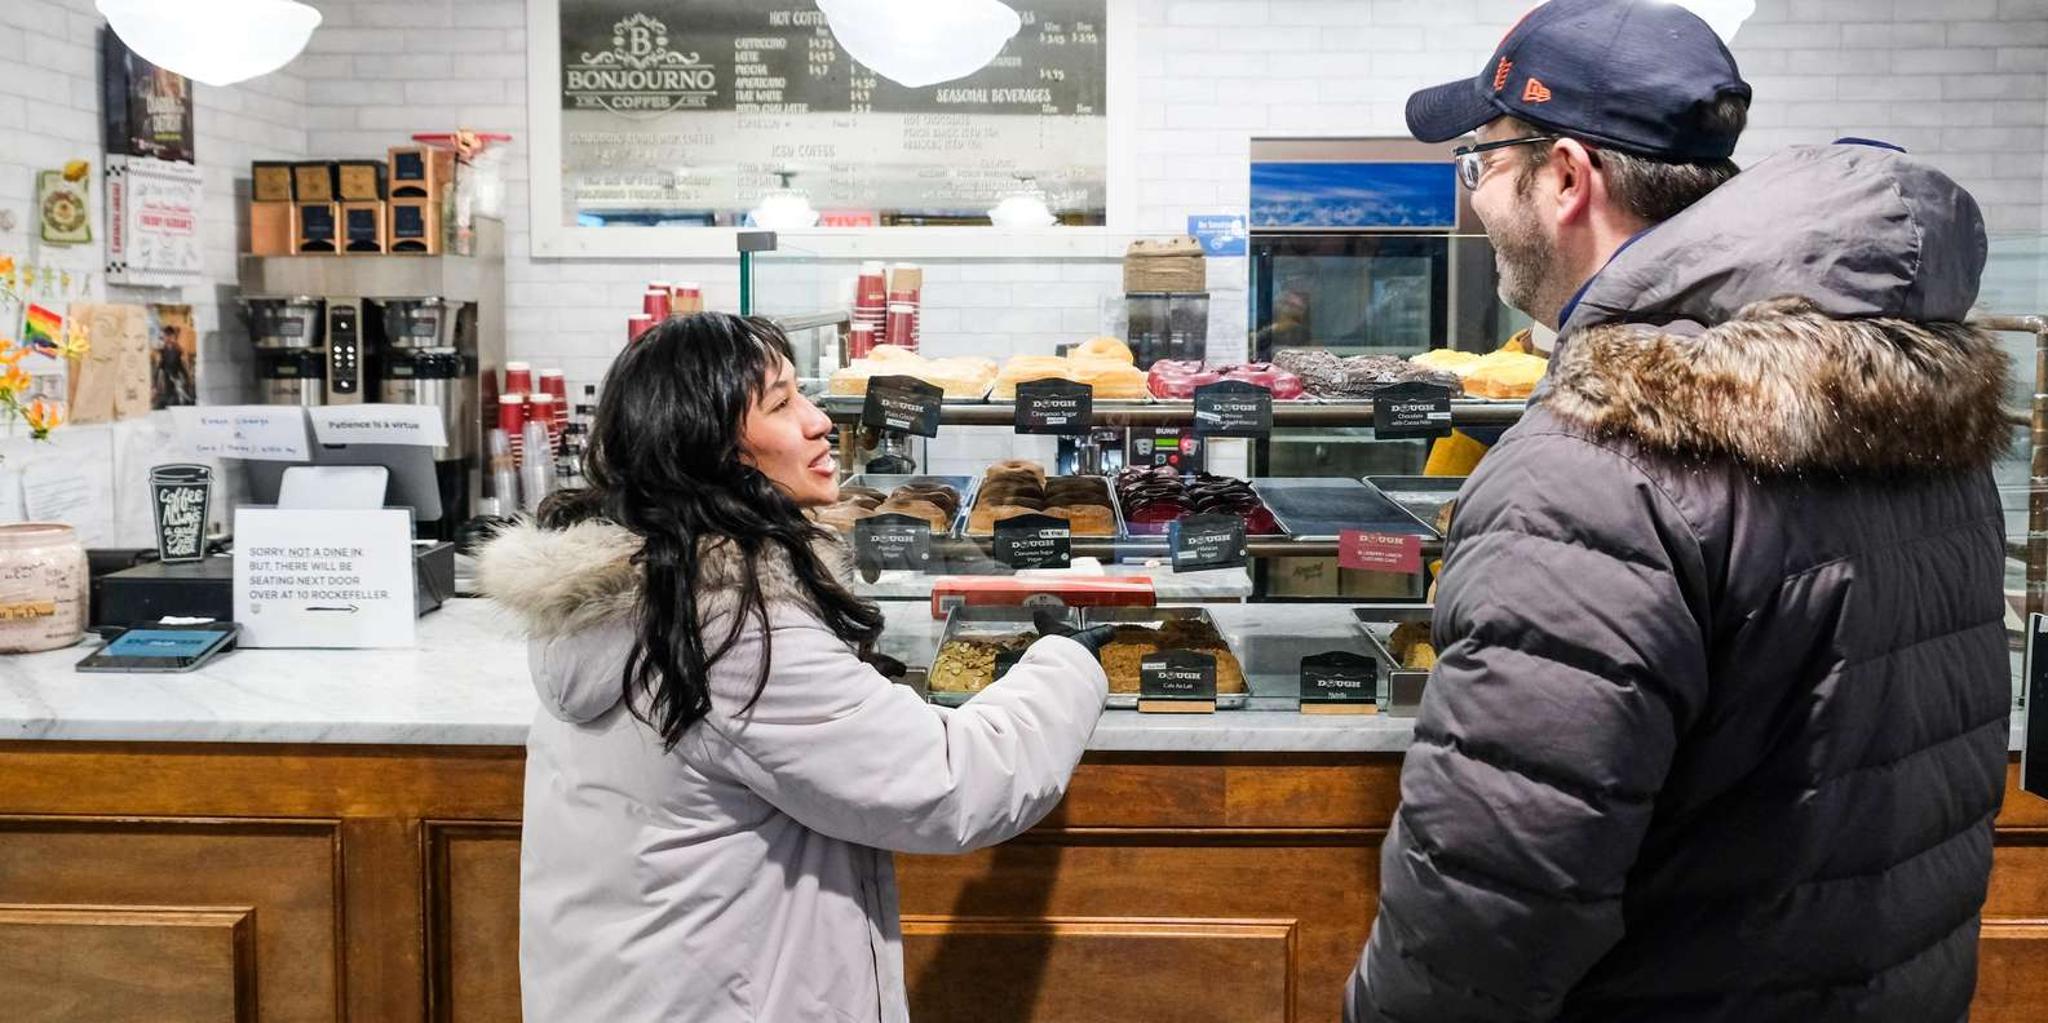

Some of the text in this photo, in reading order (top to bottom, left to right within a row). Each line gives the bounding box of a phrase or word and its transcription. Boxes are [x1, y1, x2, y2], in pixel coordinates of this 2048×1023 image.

[769, 11, 791, 26] HOT
[630, 27, 651, 56] B
[566, 70, 716, 90] BONJOURNO
[936, 88, 1052, 103] SEASONAL BEVERAGES
[612, 96, 670, 109] COFFEE
[881, 399, 925, 413] DOUGH
[1033, 400, 1077, 408] DOUGH
[1213, 403, 1257, 412] DOUGH
[1391, 404, 1435, 412] DOUGH
[328, 420, 371, 429] Patience
[391, 421, 420, 429] virtue
[1155, 427, 1180, 435] BUNN
[160, 487, 204, 512] Coffee
[871, 535, 914, 543] DOUGH
[1012, 539, 1055, 549] DOUGH
[1187, 534, 1231, 545] DOUGH
[1359, 535, 1404, 545] DOUGH
[288, 547, 310, 557] NOT
[314, 547, 321, 556] A
[322, 547, 349, 557] DINE
[275, 561, 309, 571] THERE
[311, 561, 336, 571] WILL
[339, 561, 352, 571] BE
[249, 576, 360, 586] SEATING NEXT DOOR
[249, 590, 391, 600] OVER AT 10 ROCKEFELLER.
[1158, 671, 1201, 680] DOUGH
[1317, 679, 1361, 688] DOUGH
